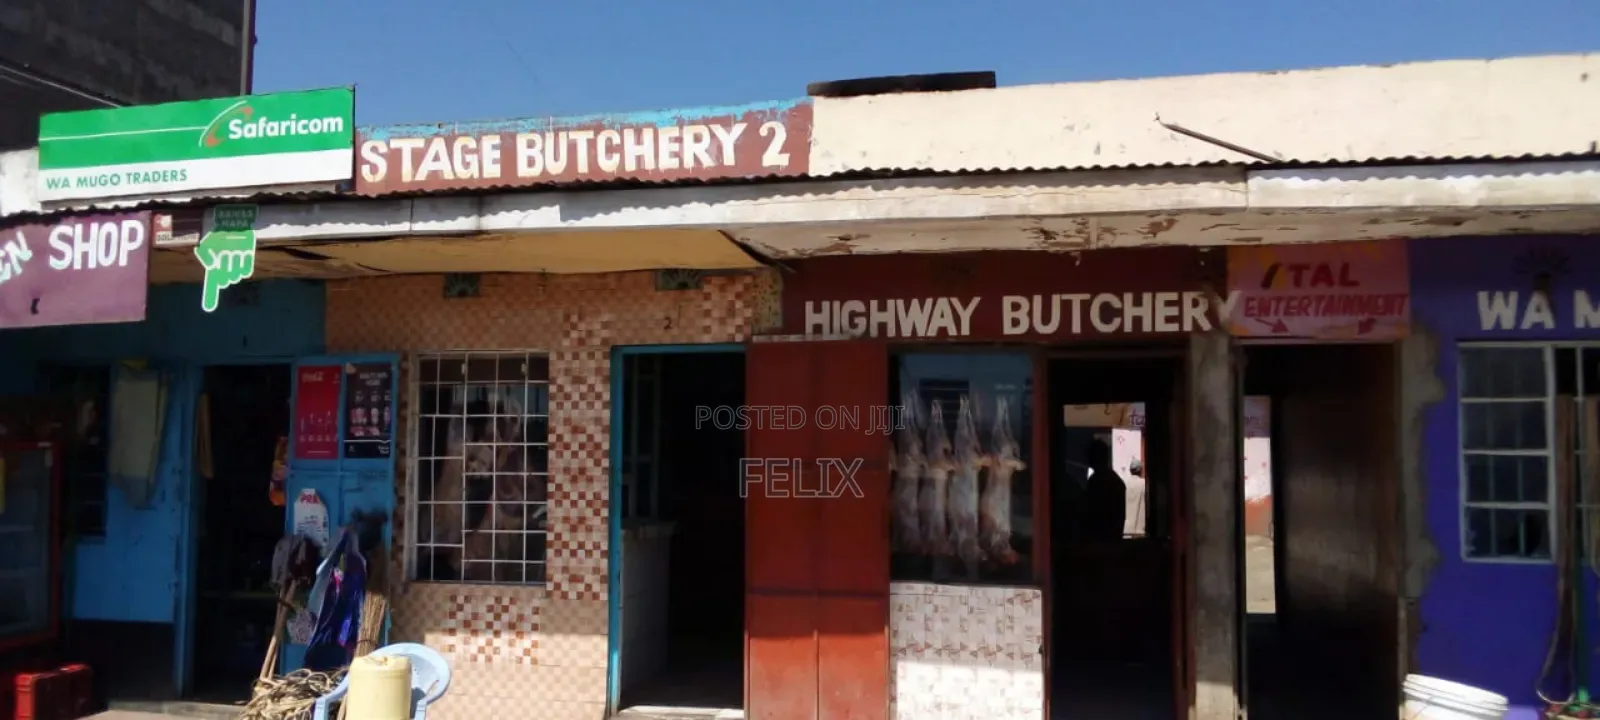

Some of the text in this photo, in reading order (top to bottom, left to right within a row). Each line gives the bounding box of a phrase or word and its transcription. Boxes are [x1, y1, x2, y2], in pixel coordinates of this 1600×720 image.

[228, 114, 344, 140] Safaricom
[360, 121, 790, 182] STAGE BUTCHERY 2
[46, 168, 188, 190] WA MUGO TRADERS
[48, 219, 144, 270] SHOP
[804, 290, 1242, 336] HIGHWAY BUTCHERY
[1244, 292, 1409, 318] ENTERTAINMENT
[1476, 290, 1556, 331] WA
